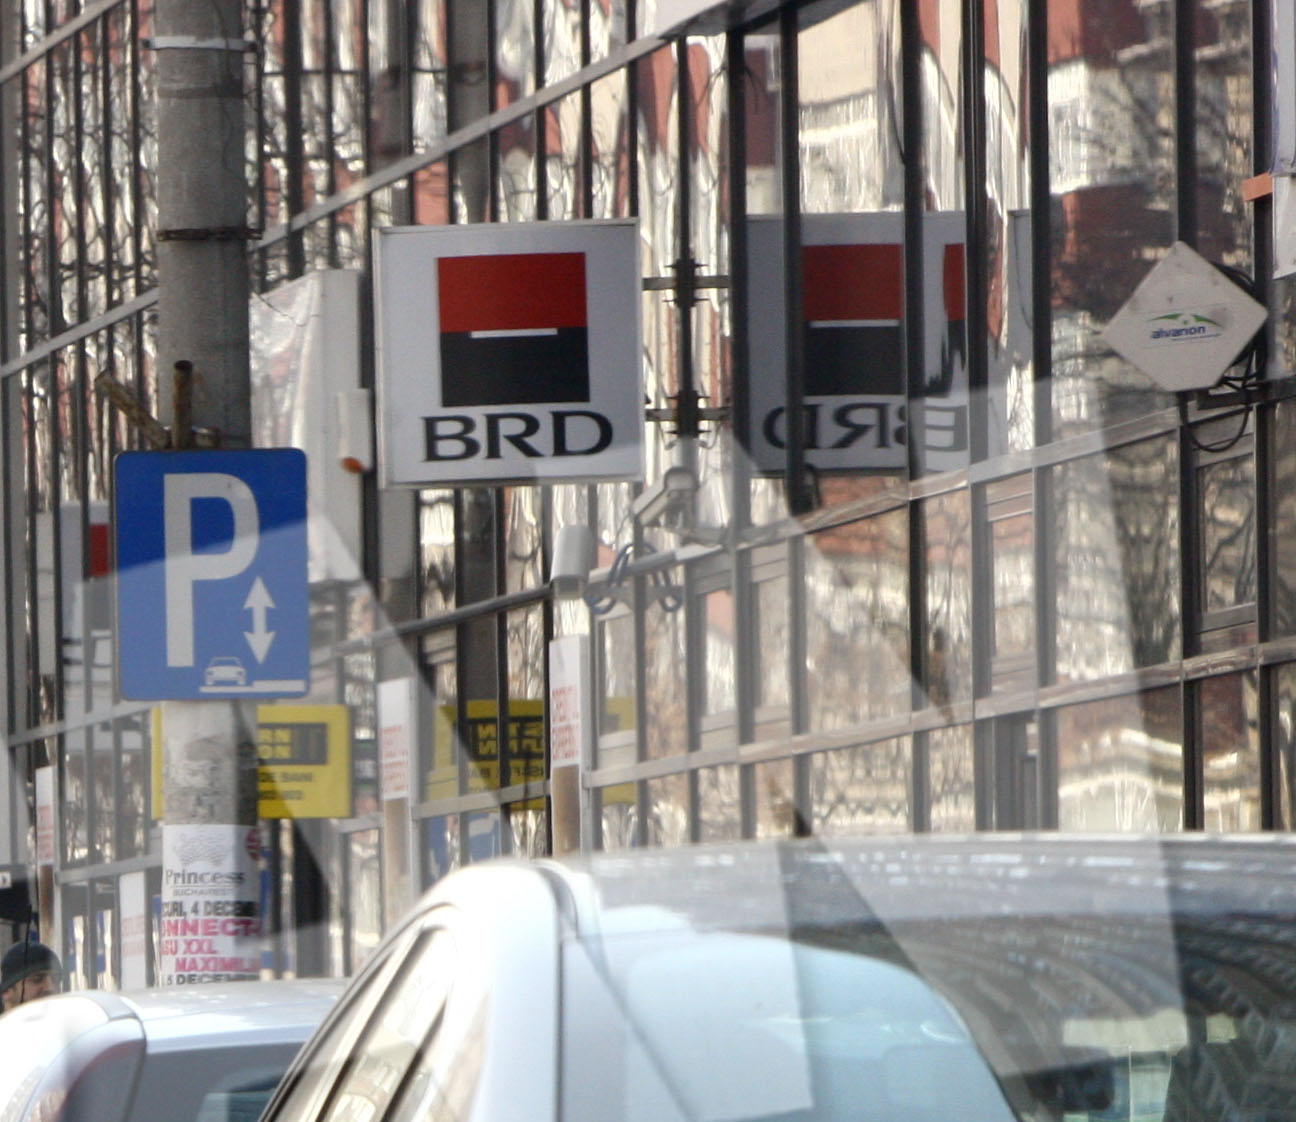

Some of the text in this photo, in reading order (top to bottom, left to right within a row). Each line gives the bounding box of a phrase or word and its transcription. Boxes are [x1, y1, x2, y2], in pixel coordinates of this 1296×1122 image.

[421, 409, 613, 462] BRD
[164, 472, 258, 667] P
[165, 868, 246, 885] Princess
